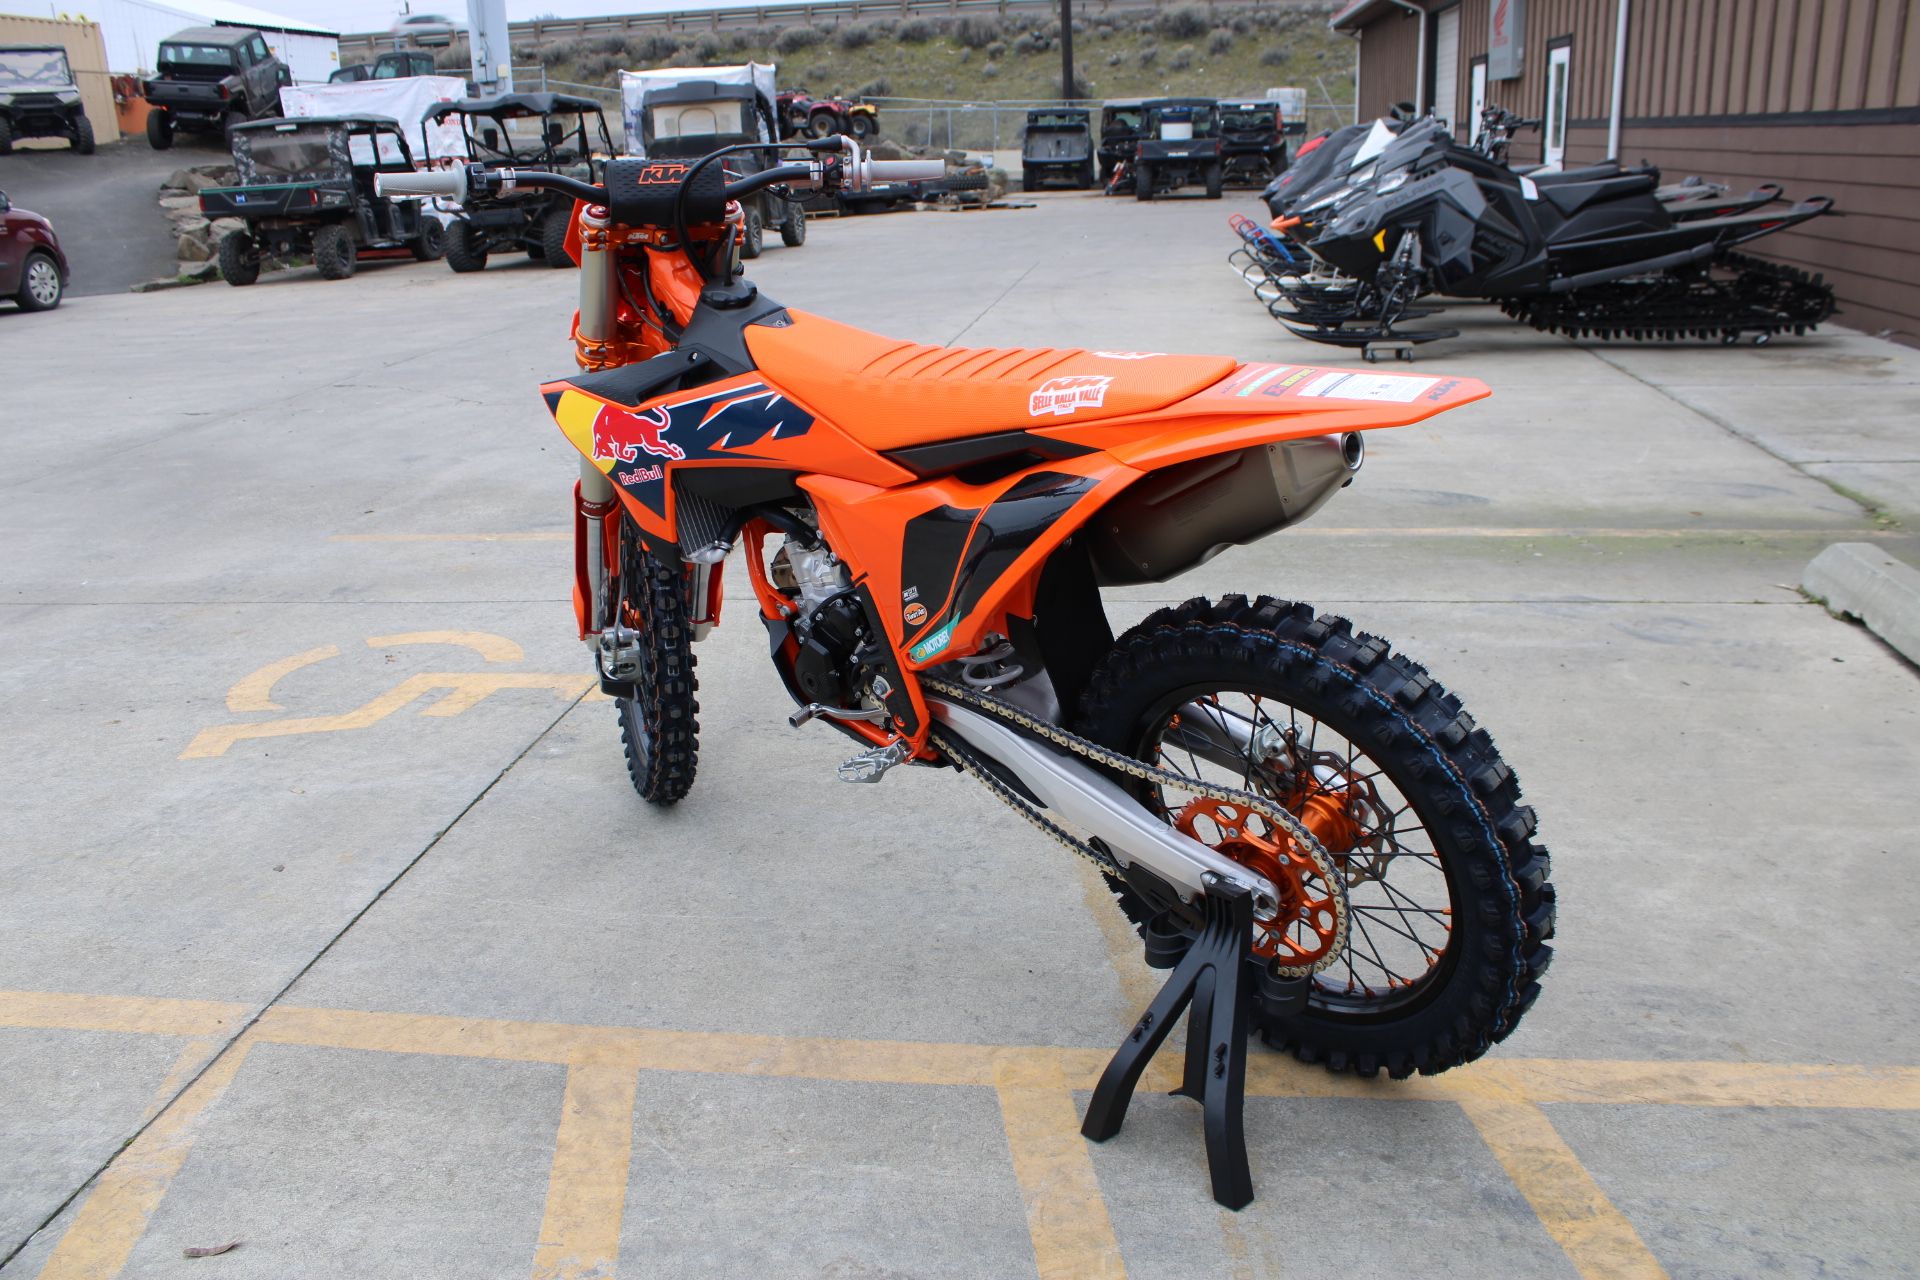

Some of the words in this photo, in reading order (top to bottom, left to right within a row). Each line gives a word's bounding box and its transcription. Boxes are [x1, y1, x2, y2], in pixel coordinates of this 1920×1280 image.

[1033, 395, 1053, 411] SELLE
[1079, 387, 1101, 401] VALLE
[923, 629, 950, 654] MOTOREX
